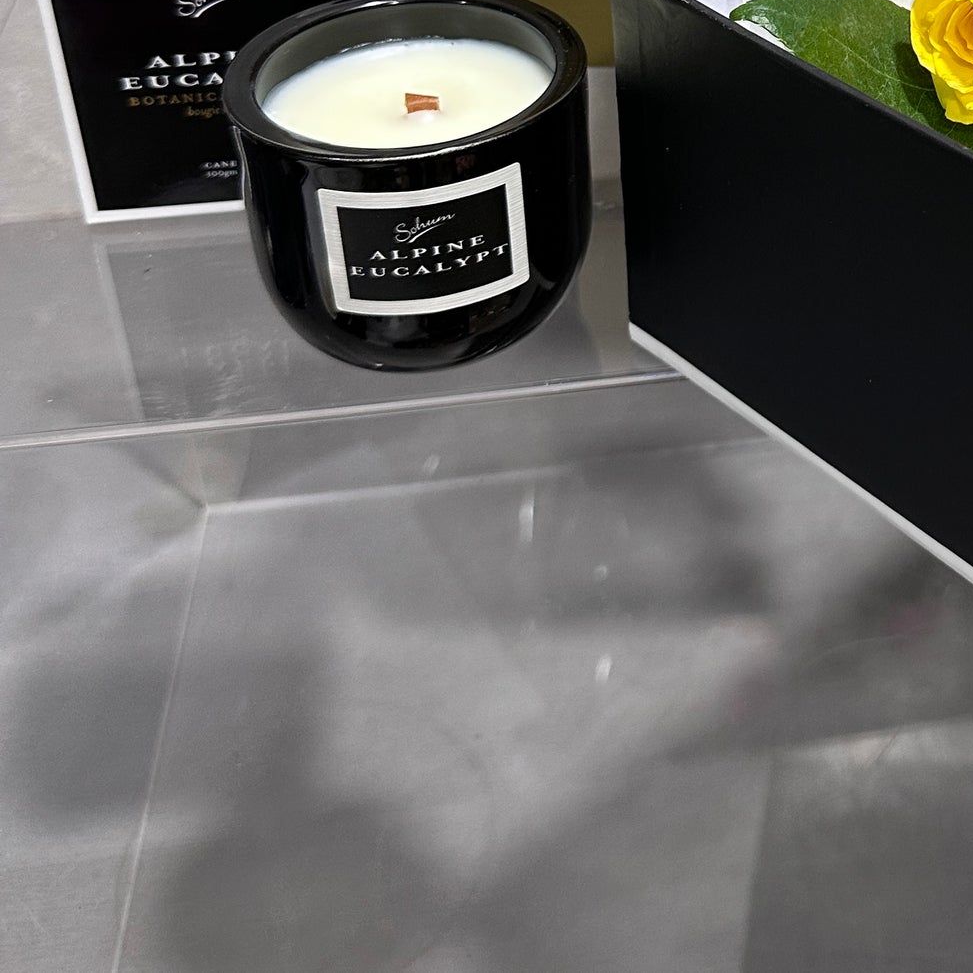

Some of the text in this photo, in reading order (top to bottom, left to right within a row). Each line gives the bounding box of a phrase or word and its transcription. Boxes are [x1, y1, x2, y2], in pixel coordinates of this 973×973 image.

[119, 72, 224, 91] EUCA
[350, 243, 509, 277] EUCALYPT
[369, 234, 486, 261] ALPINE
